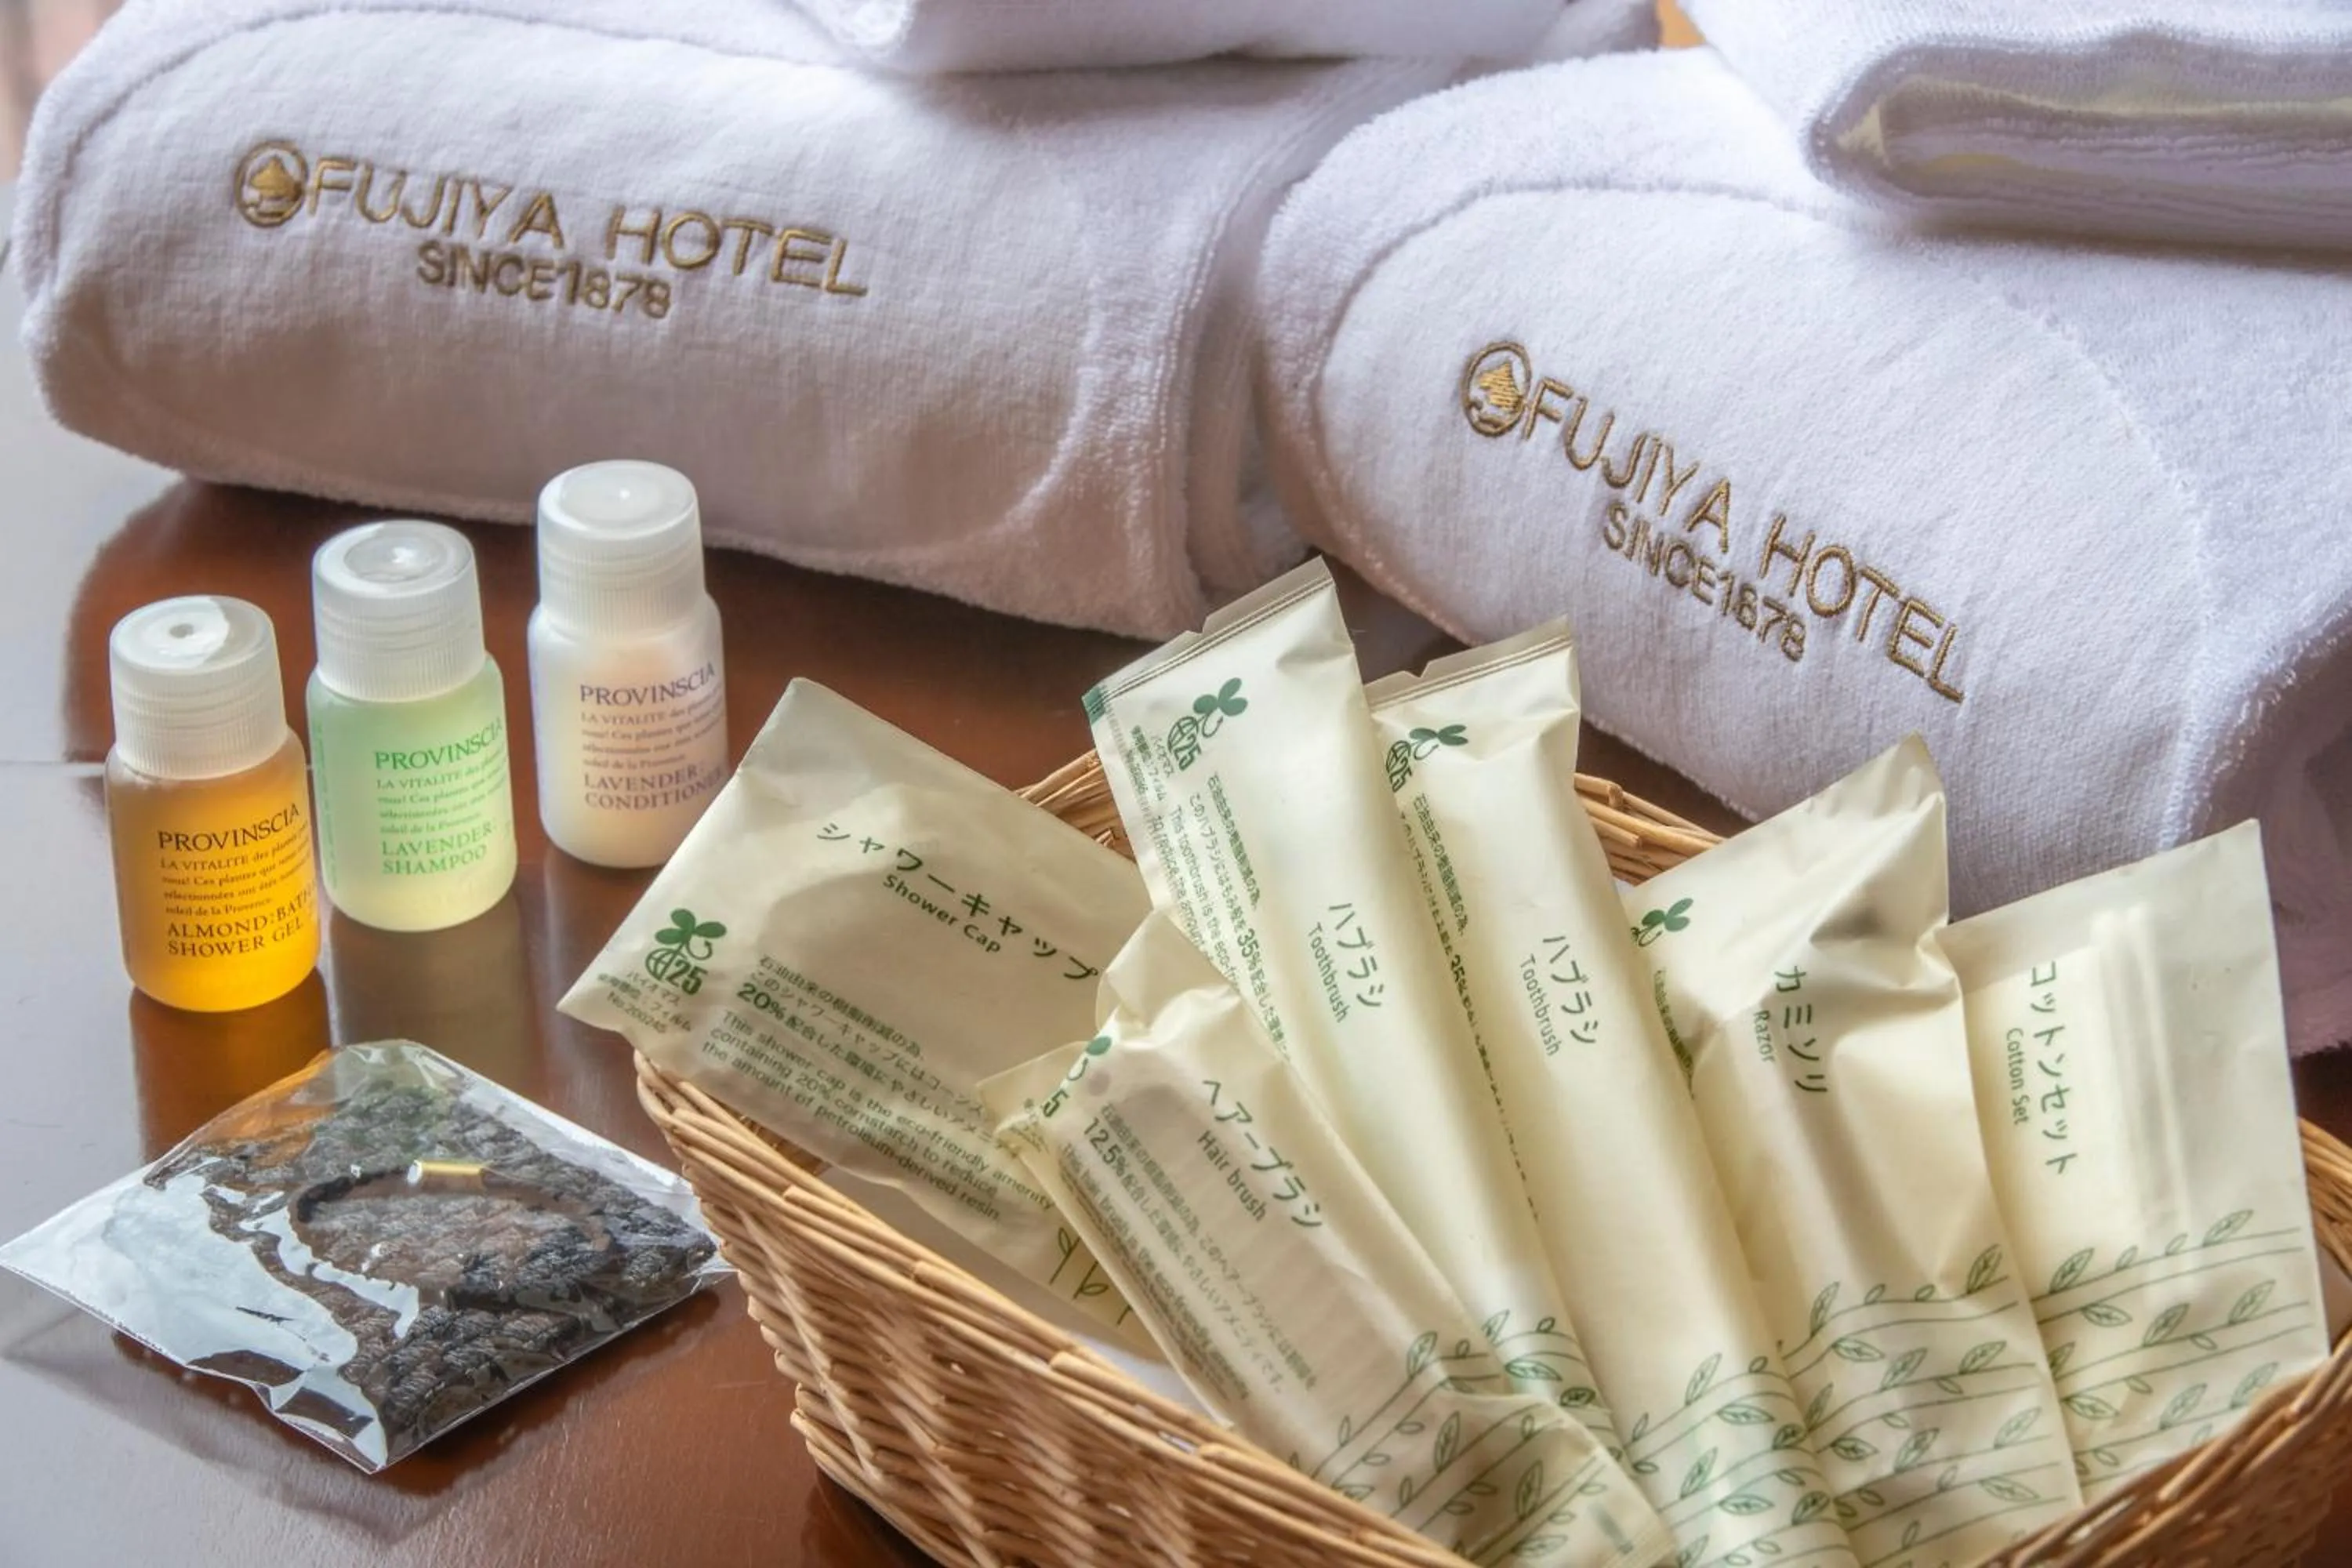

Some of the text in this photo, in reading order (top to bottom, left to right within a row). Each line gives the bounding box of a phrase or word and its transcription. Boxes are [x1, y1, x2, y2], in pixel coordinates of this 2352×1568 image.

[307, 157, 868, 298] FUJIYA HOTEL
[1523, 376, 1965, 703] FUJIYA HOTEL
[579, 661, 715, 706] PROVINSCIA
[374, 716, 503, 771] PROVINSCIA
[158, 802, 300, 851] PROVINSCIA
[160, 856, 178, 870] LA
[382, 844, 487, 875] SHAMPOO
[168, 916, 304, 958] SHOWER GEL
[816, 822, 1099, 980] シャワーキャップ
[882, 873, 1001, 953] Shower Cap
[1307, 921, 1350, 1024] Toothbrush
[1328, 902, 1382, 1009] ハブラシ
[1519, 953, 1561, 1057] Toothbrush
[1542, 935, 1597, 1046] ハブラシ
[702, 1040, 728, 1062] the
[731, 1057, 793, 1098] amount
[794, 1094, 815, 1108] of
[1753, 1009, 1776, 1064] Razor
[1773, 964, 1828, 1094] カミソリ
[2005, 1025, 2031, 1127] Cotton Set
[2028, 960, 2079, 1175] コットンセット
[710, 1028, 793, 1079] containing
[922, 1146, 939, 1163] to
[942, 1158, 999, 1197] reduce
[723, 1010, 753, 1036] This
[758, 1033, 814, 1069] shower
[817, 1069, 846, 1091] cap
[848, 1087, 863, 1103] is
[866, 1098, 892, 1118] the
[896, 1115, 989, 1173] eco-friendly
[992, 1169, 1055, 1211] amenity
[1202, 1078, 1323, 1229] ヘアーブラシ
[1197, 1130, 1268, 1223] Hair brush
